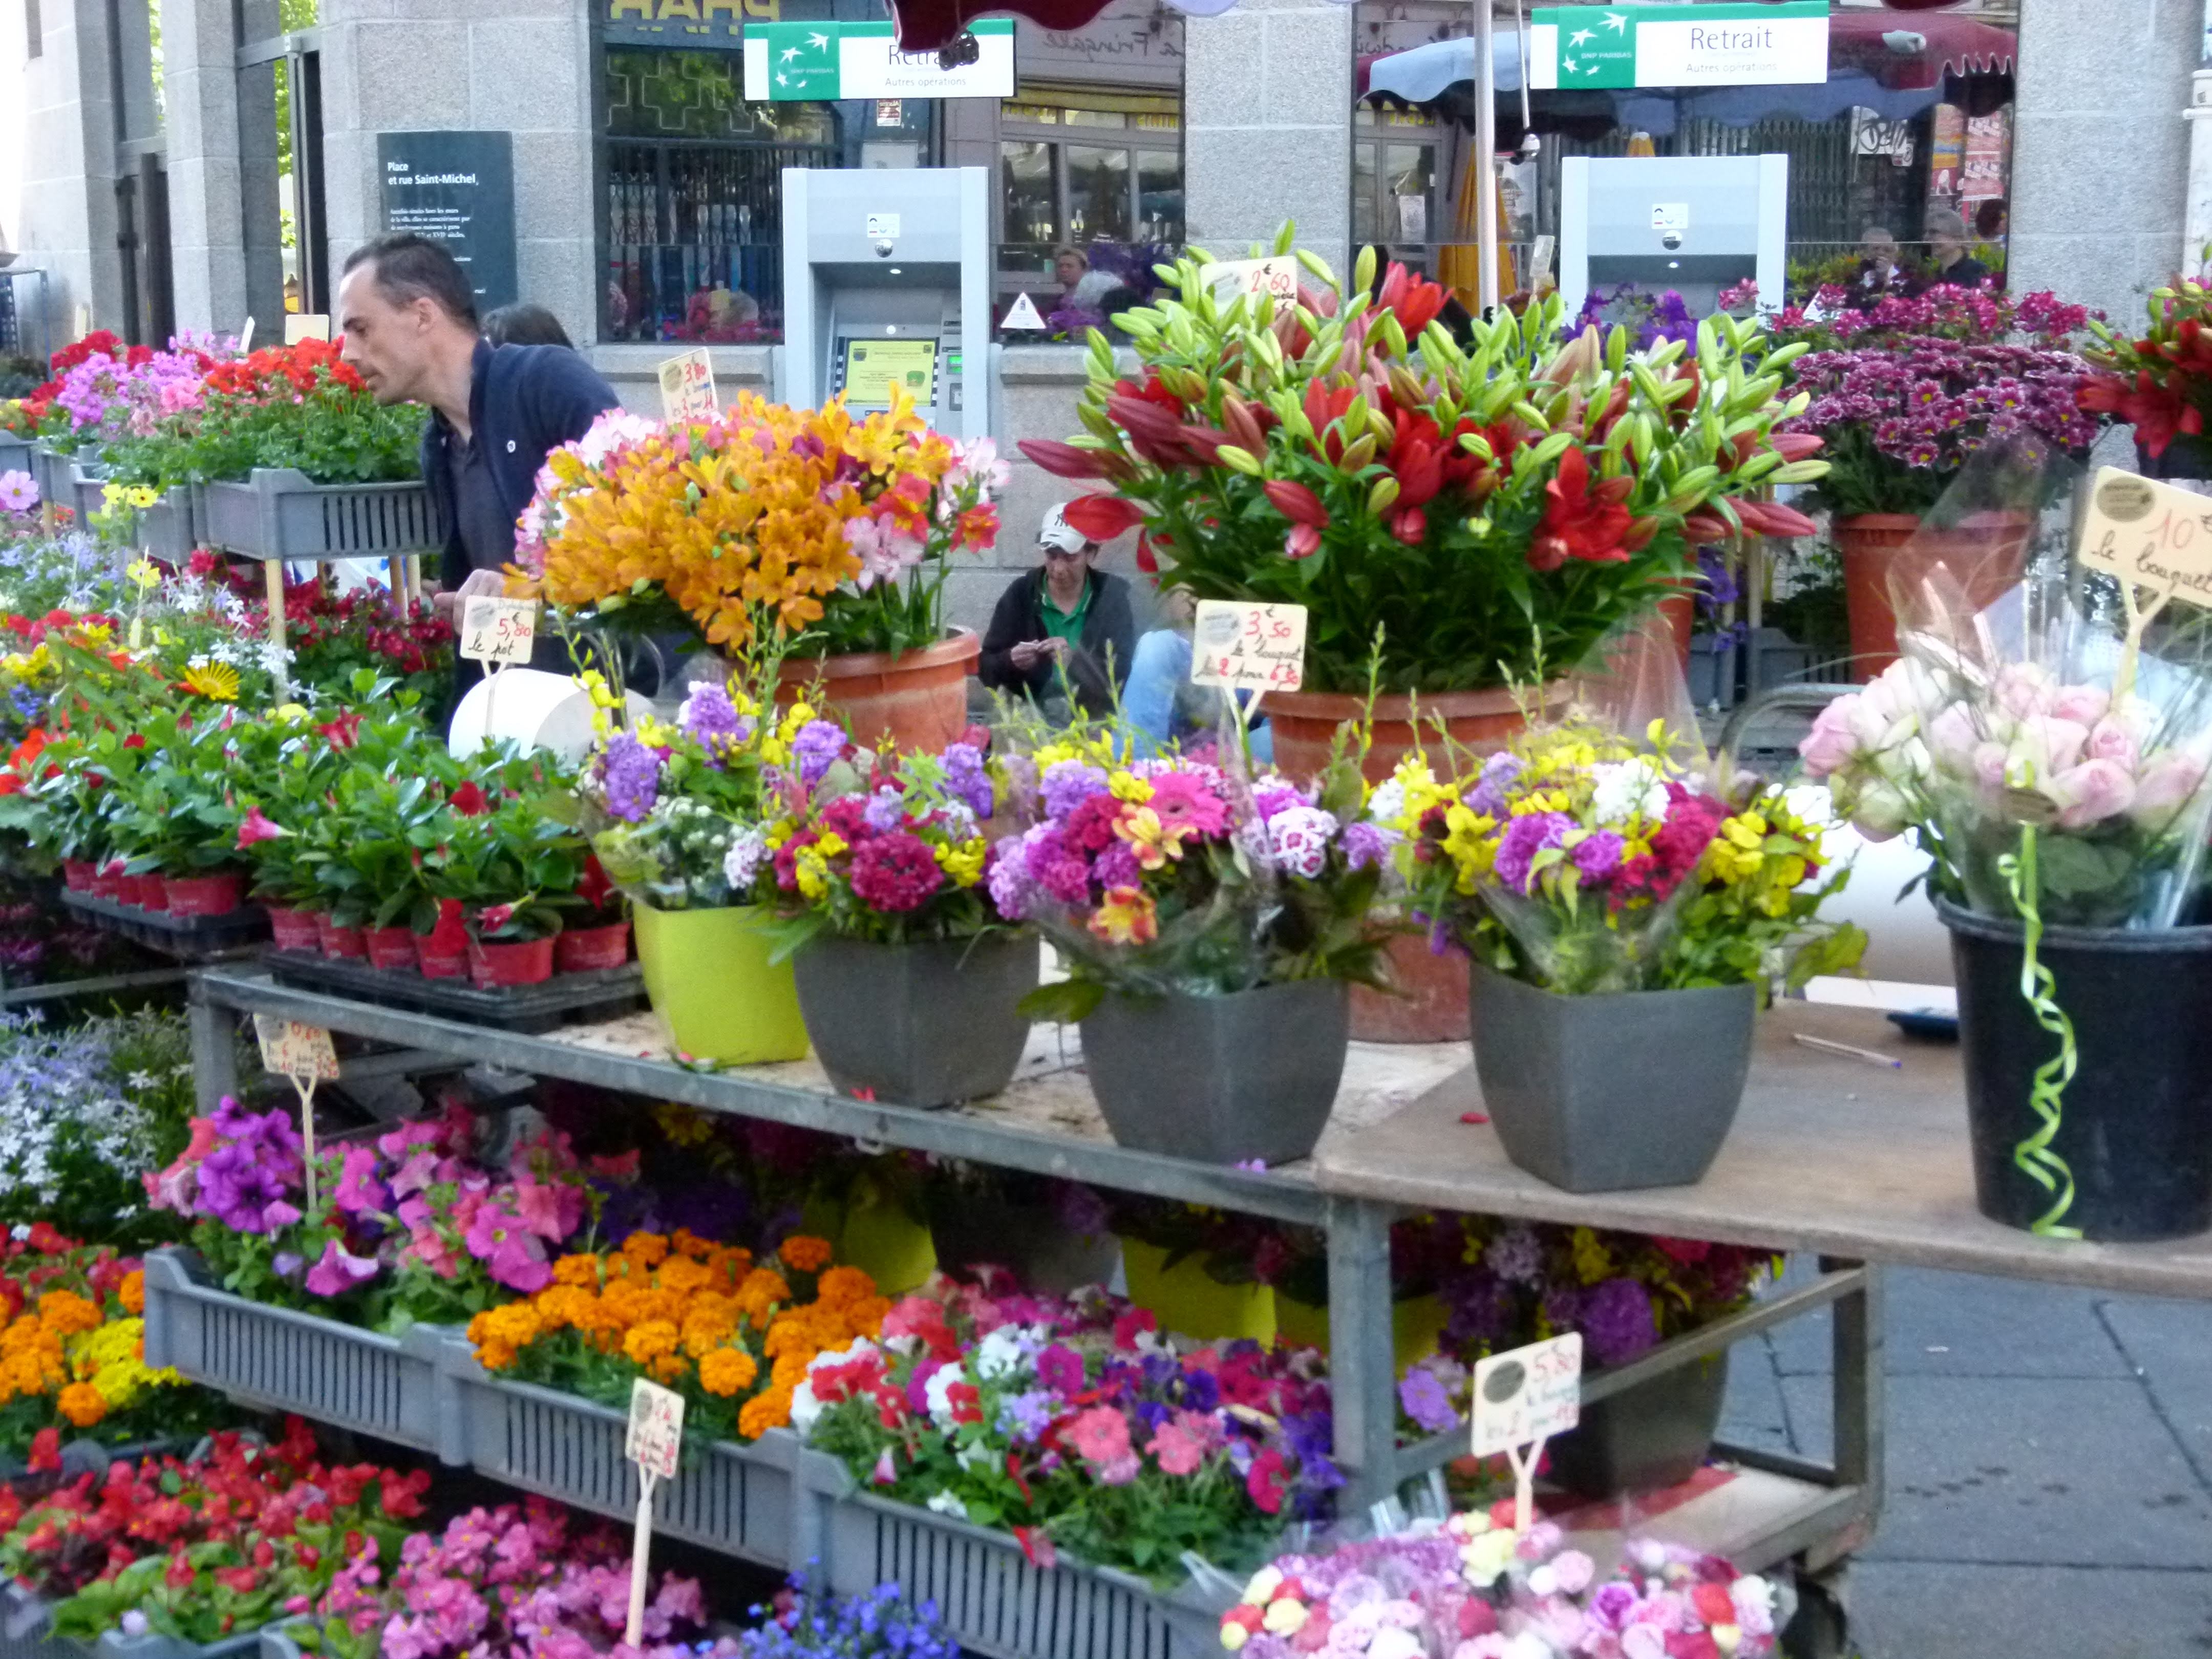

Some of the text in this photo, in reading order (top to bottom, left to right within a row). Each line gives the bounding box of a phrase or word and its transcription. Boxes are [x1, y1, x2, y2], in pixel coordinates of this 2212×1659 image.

[1691, 27, 1773, 50] Retrait
[889, 45, 940, 66] Retra
[1686, 62, 1719, 73] Autres
[885, 76, 966, 88] Autres opérations
[388, 162, 409, 172] Place
[388, 176, 397, 185] et
[468, 630, 514, 661] le pot
[1218, 657, 1229, 676] 2
